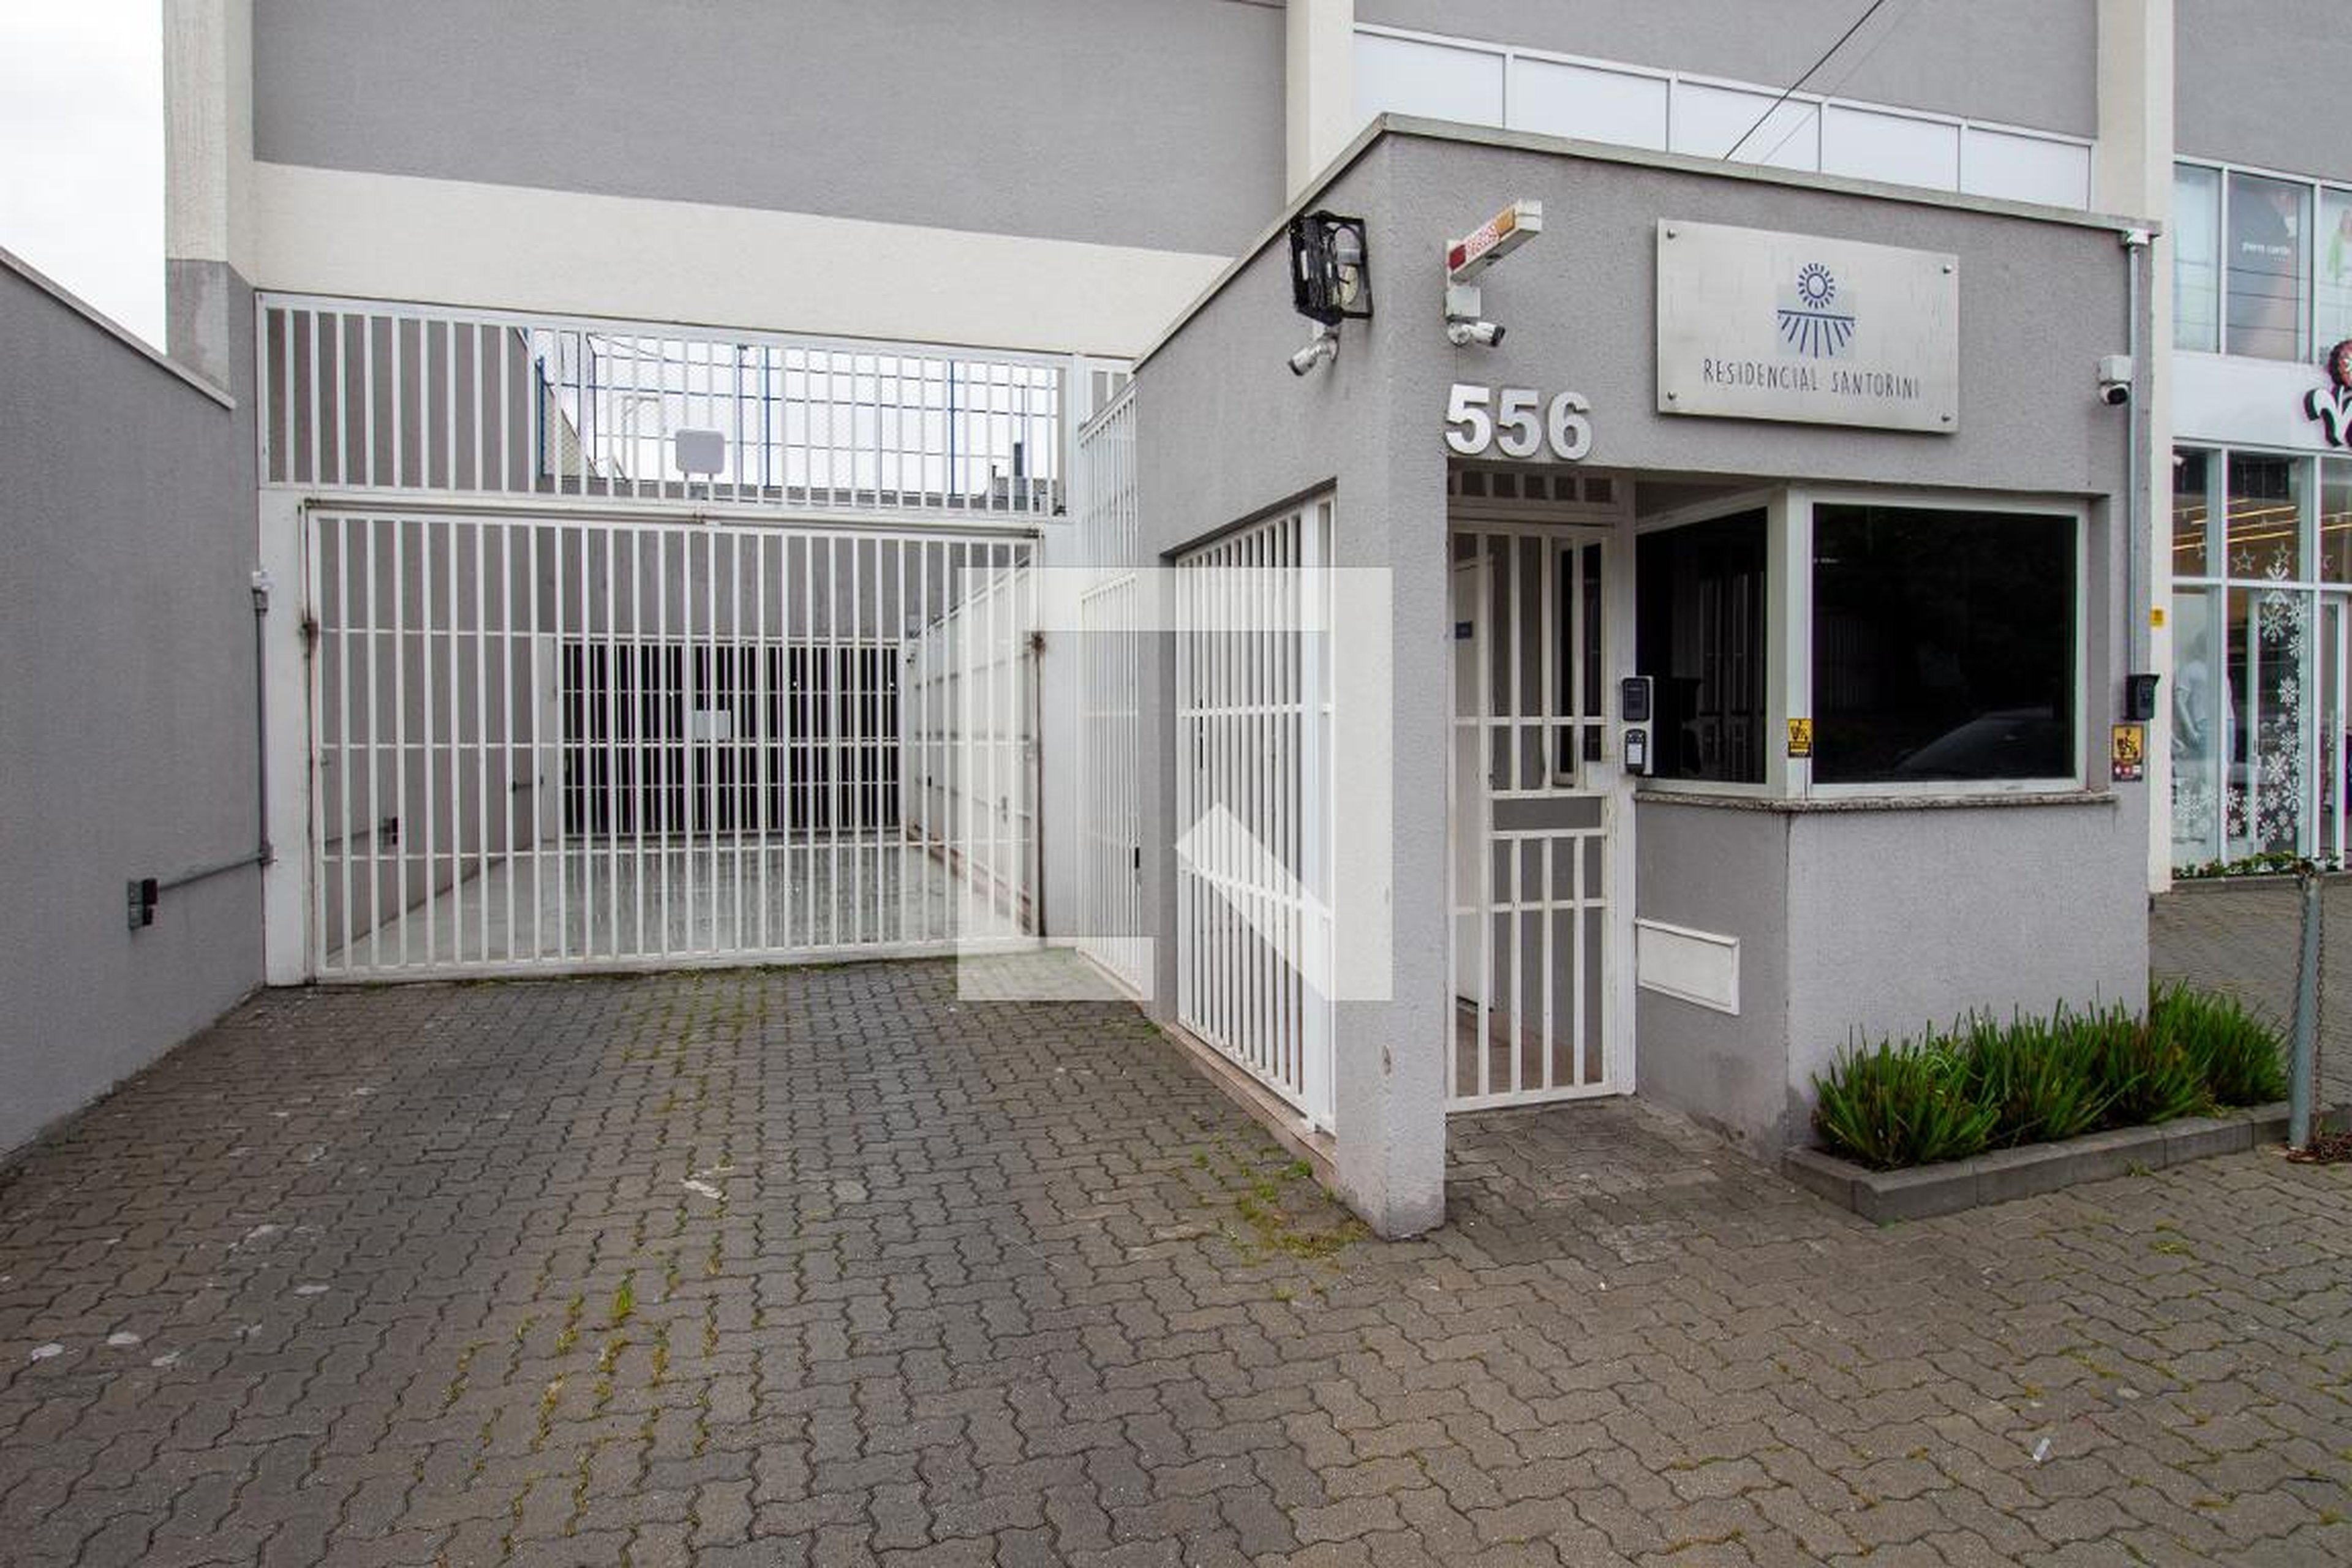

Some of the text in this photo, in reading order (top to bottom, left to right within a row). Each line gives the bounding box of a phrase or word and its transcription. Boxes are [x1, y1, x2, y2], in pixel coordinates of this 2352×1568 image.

[1703, 358, 1920, 399] RESIDENCIAL SANTORINI
[1445, 383, 1593, 460] 556
